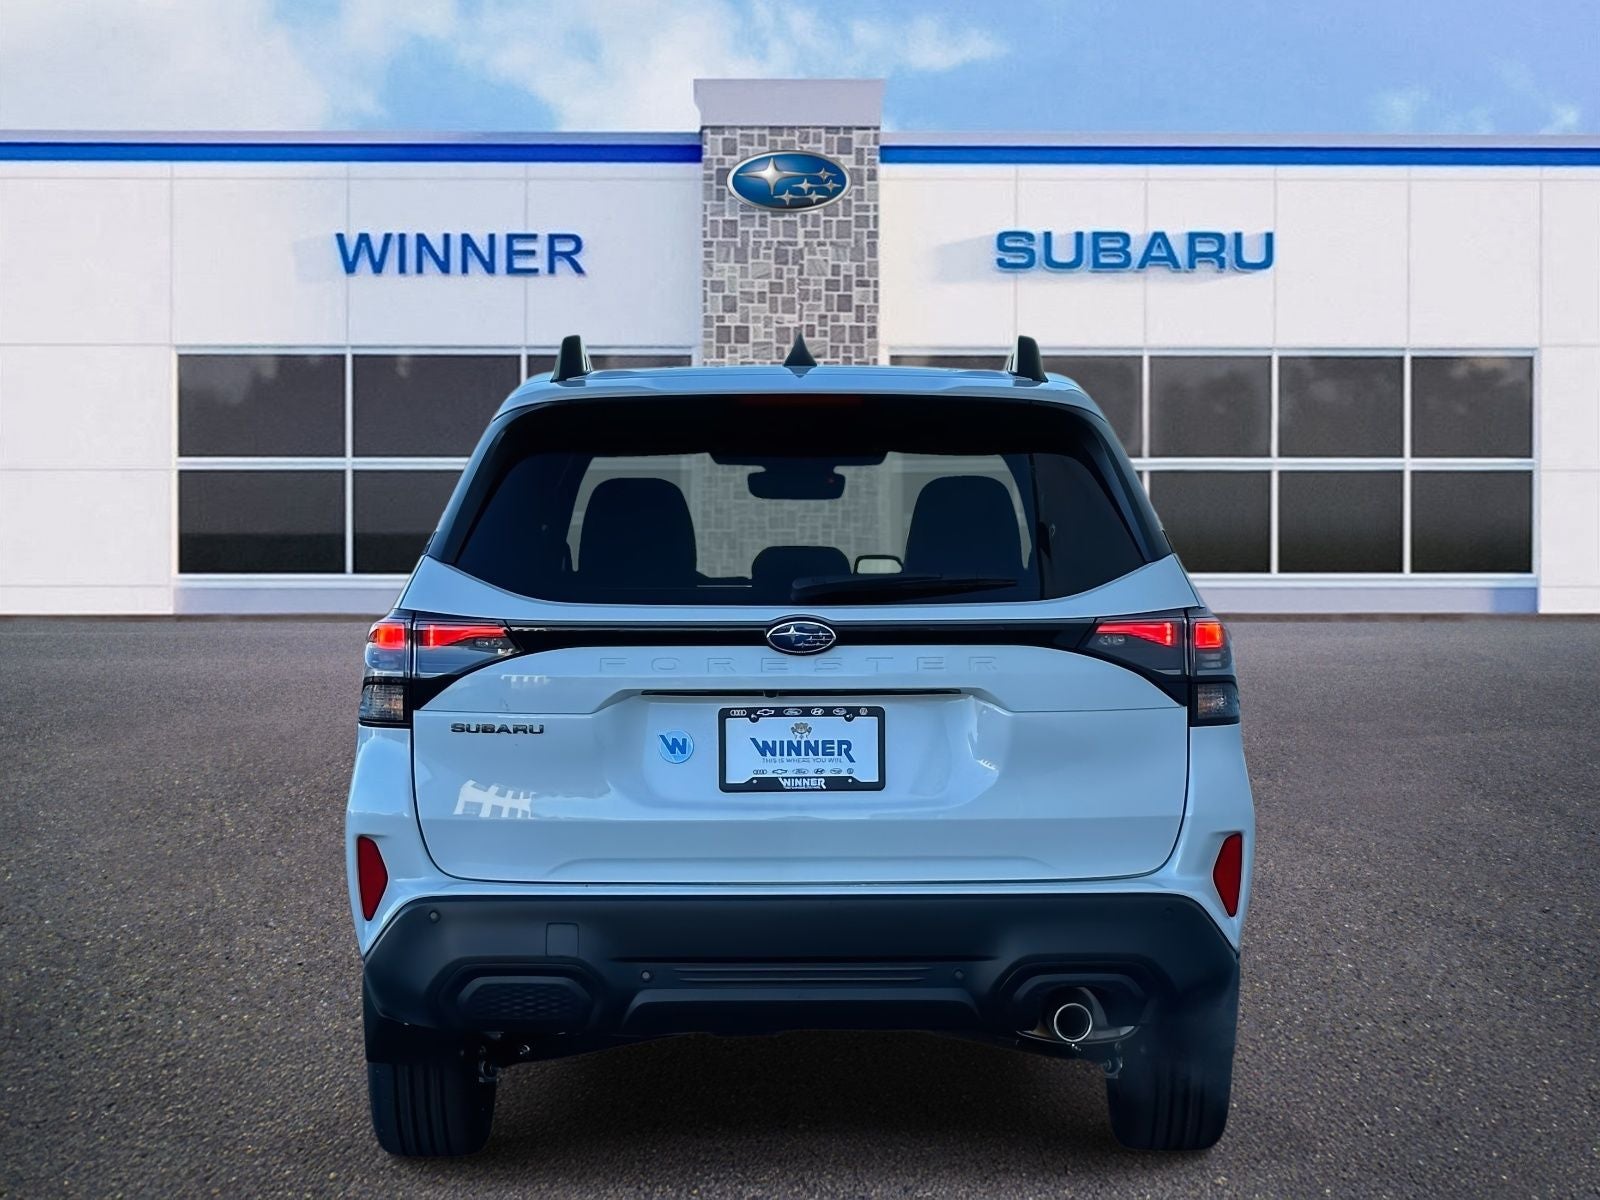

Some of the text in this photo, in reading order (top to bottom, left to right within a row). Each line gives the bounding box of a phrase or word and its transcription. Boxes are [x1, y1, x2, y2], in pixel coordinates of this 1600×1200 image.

[335, 233, 586, 275] WINNER
[996, 230, 1274, 270] SUBARU
[599, 657, 999, 673] FORESTER
[450, 723, 545, 734] SUBARU
[658, 734, 687, 755] W
[750, 737, 856, 763] WINNER
[778, 777, 827, 789] WINNER
